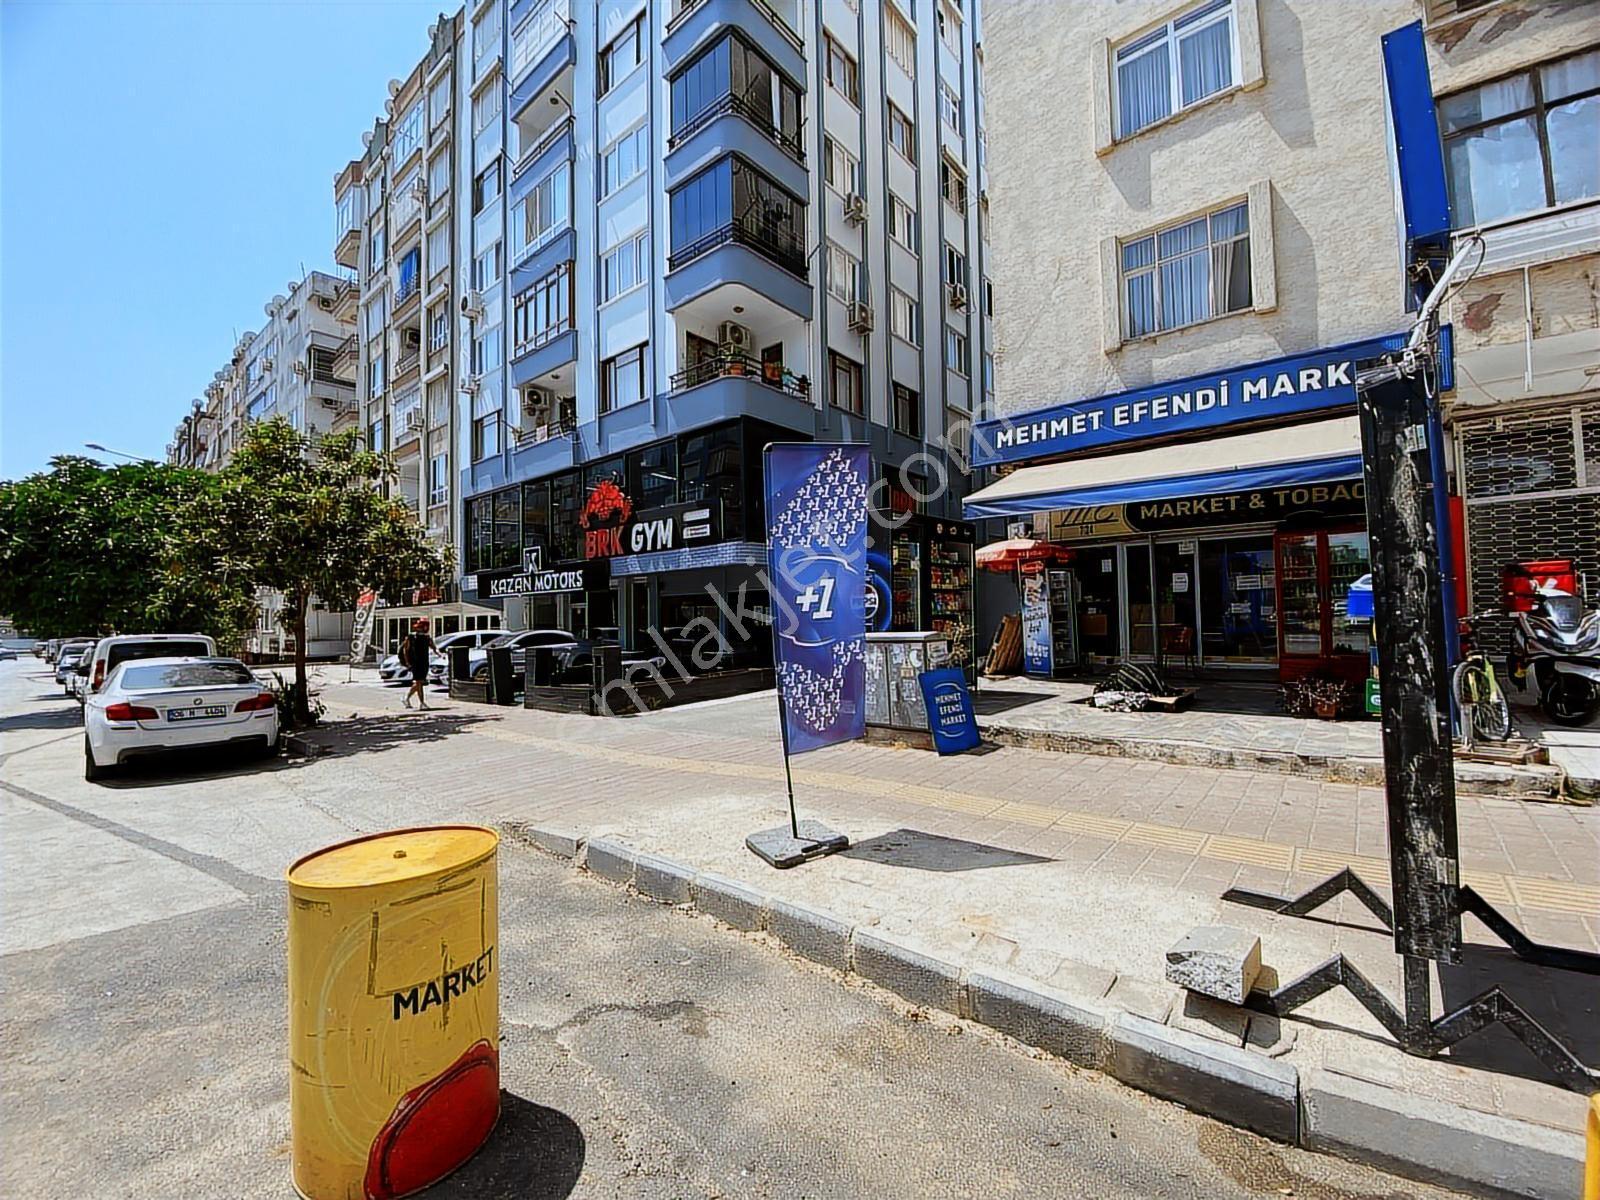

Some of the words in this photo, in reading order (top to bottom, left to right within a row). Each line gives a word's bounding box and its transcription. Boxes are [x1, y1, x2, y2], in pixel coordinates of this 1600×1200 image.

[996, 410, 1103, 450] MEHMET
[1113, 379, 1229, 426] EFENDİ
[1141, 495, 1240, 519] MARKET
[585, 526, 624, 560] BRK
[631, 518, 673, 552] GYM
[490, 576, 532, 595] KAZAN
[534, 570, 584, 592] MOTORS
[796, 578, 835, 619] +1
[393, 945, 494, 1020] MARKET
